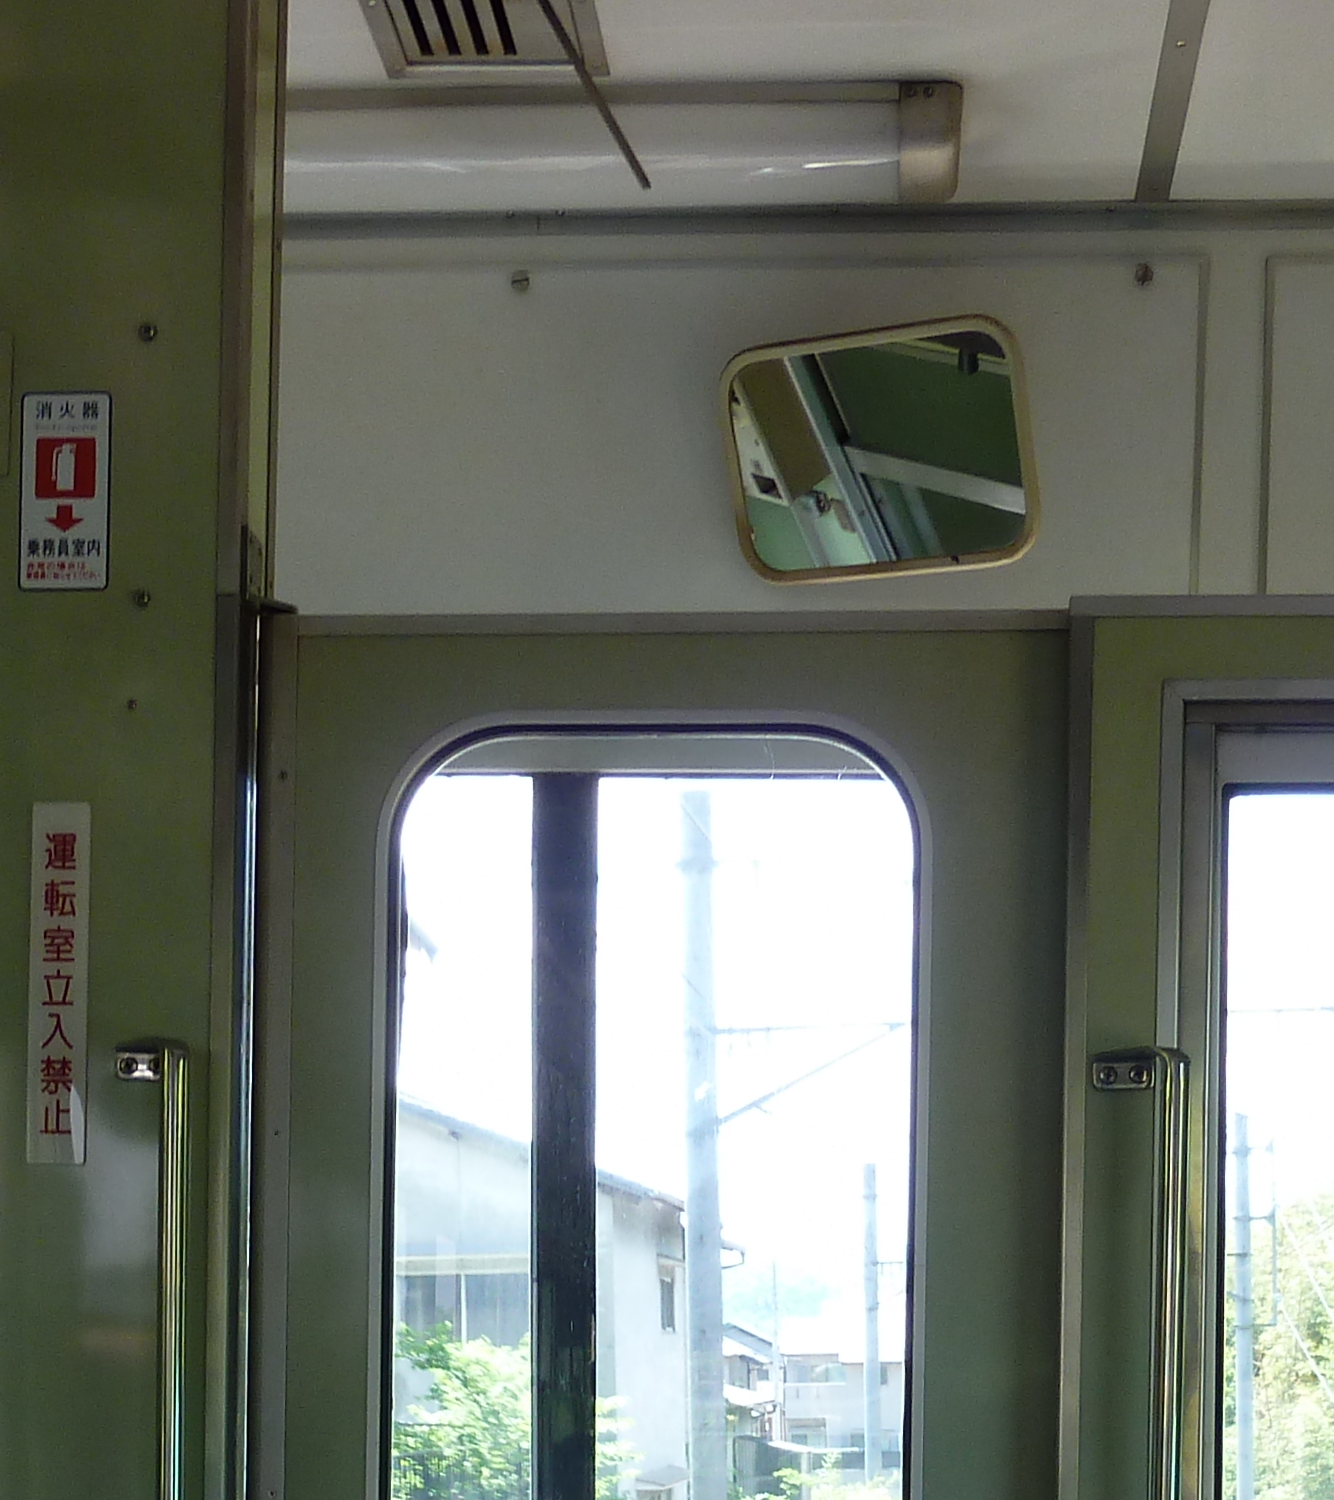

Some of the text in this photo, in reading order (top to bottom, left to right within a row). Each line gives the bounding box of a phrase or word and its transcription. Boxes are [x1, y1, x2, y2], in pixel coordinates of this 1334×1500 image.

[35, 401, 99, 420] 消火器
[27, 538, 101, 558] 乗務員室内
[40, 832, 77, 1136] 運転室立入禁止
